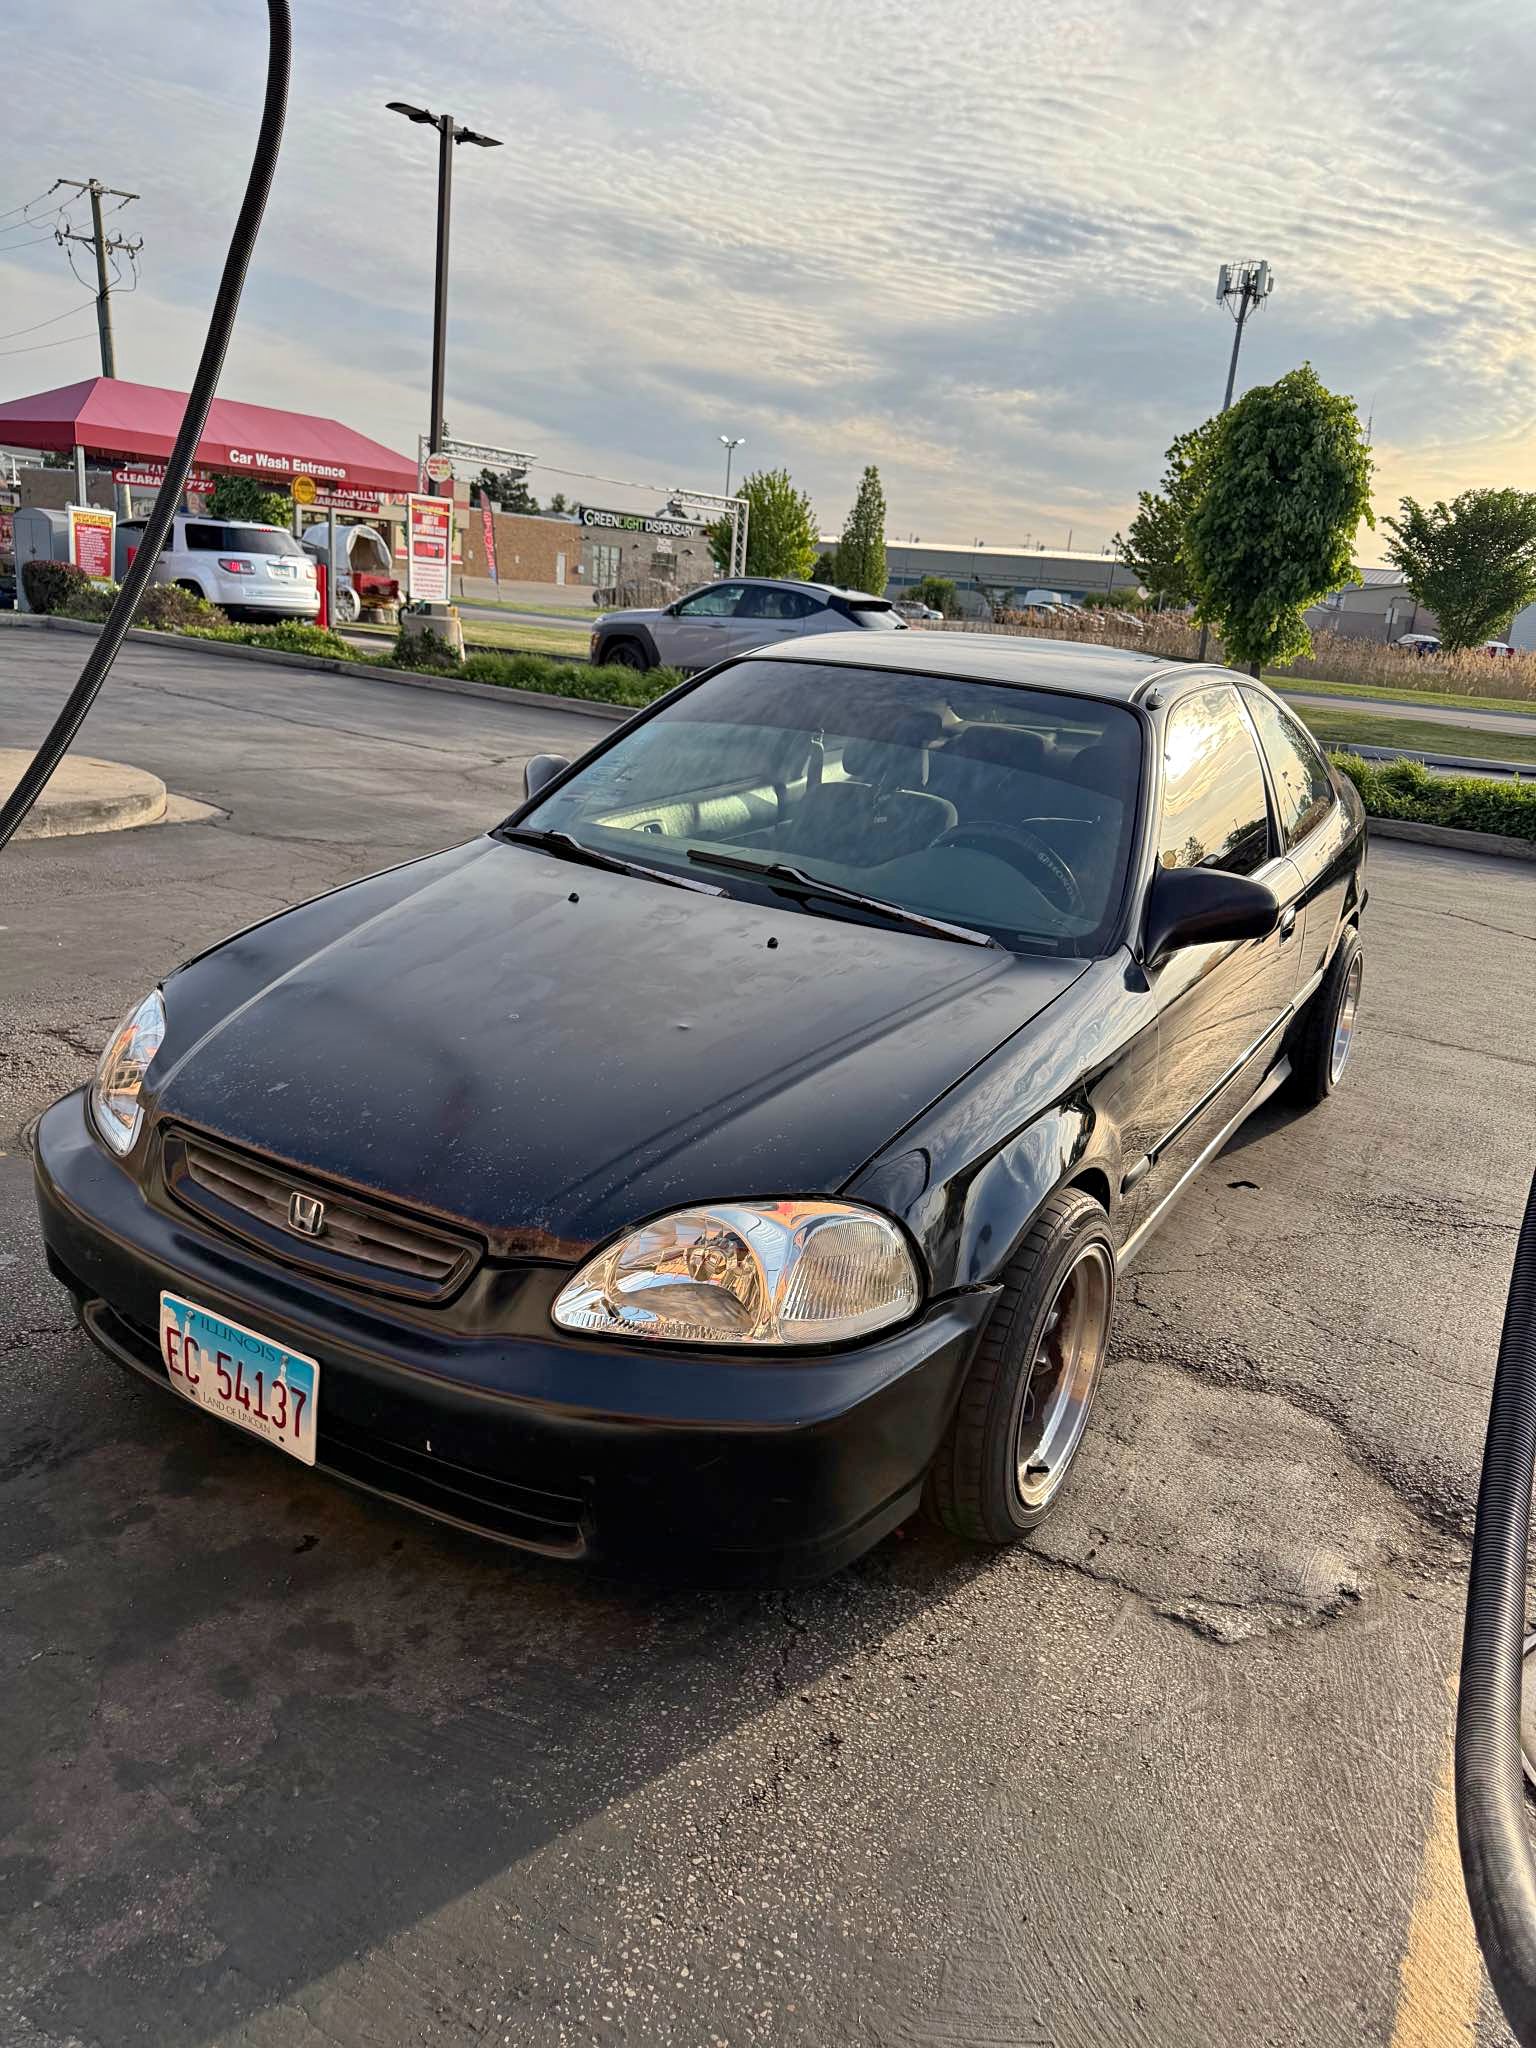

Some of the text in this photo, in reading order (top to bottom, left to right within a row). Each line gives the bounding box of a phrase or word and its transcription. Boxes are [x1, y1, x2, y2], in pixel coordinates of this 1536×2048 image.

[229, 449, 346, 478] Car Wash Entrance
[583, 508, 696, 537] GREENLIGHT DISPENSARY
[201, 1315, 276, 1363] ILLINOIS
[166, 1326, 307, 1438] EC 54137
[203, 1391, 271, 1434] LAND OF LINCOLN
